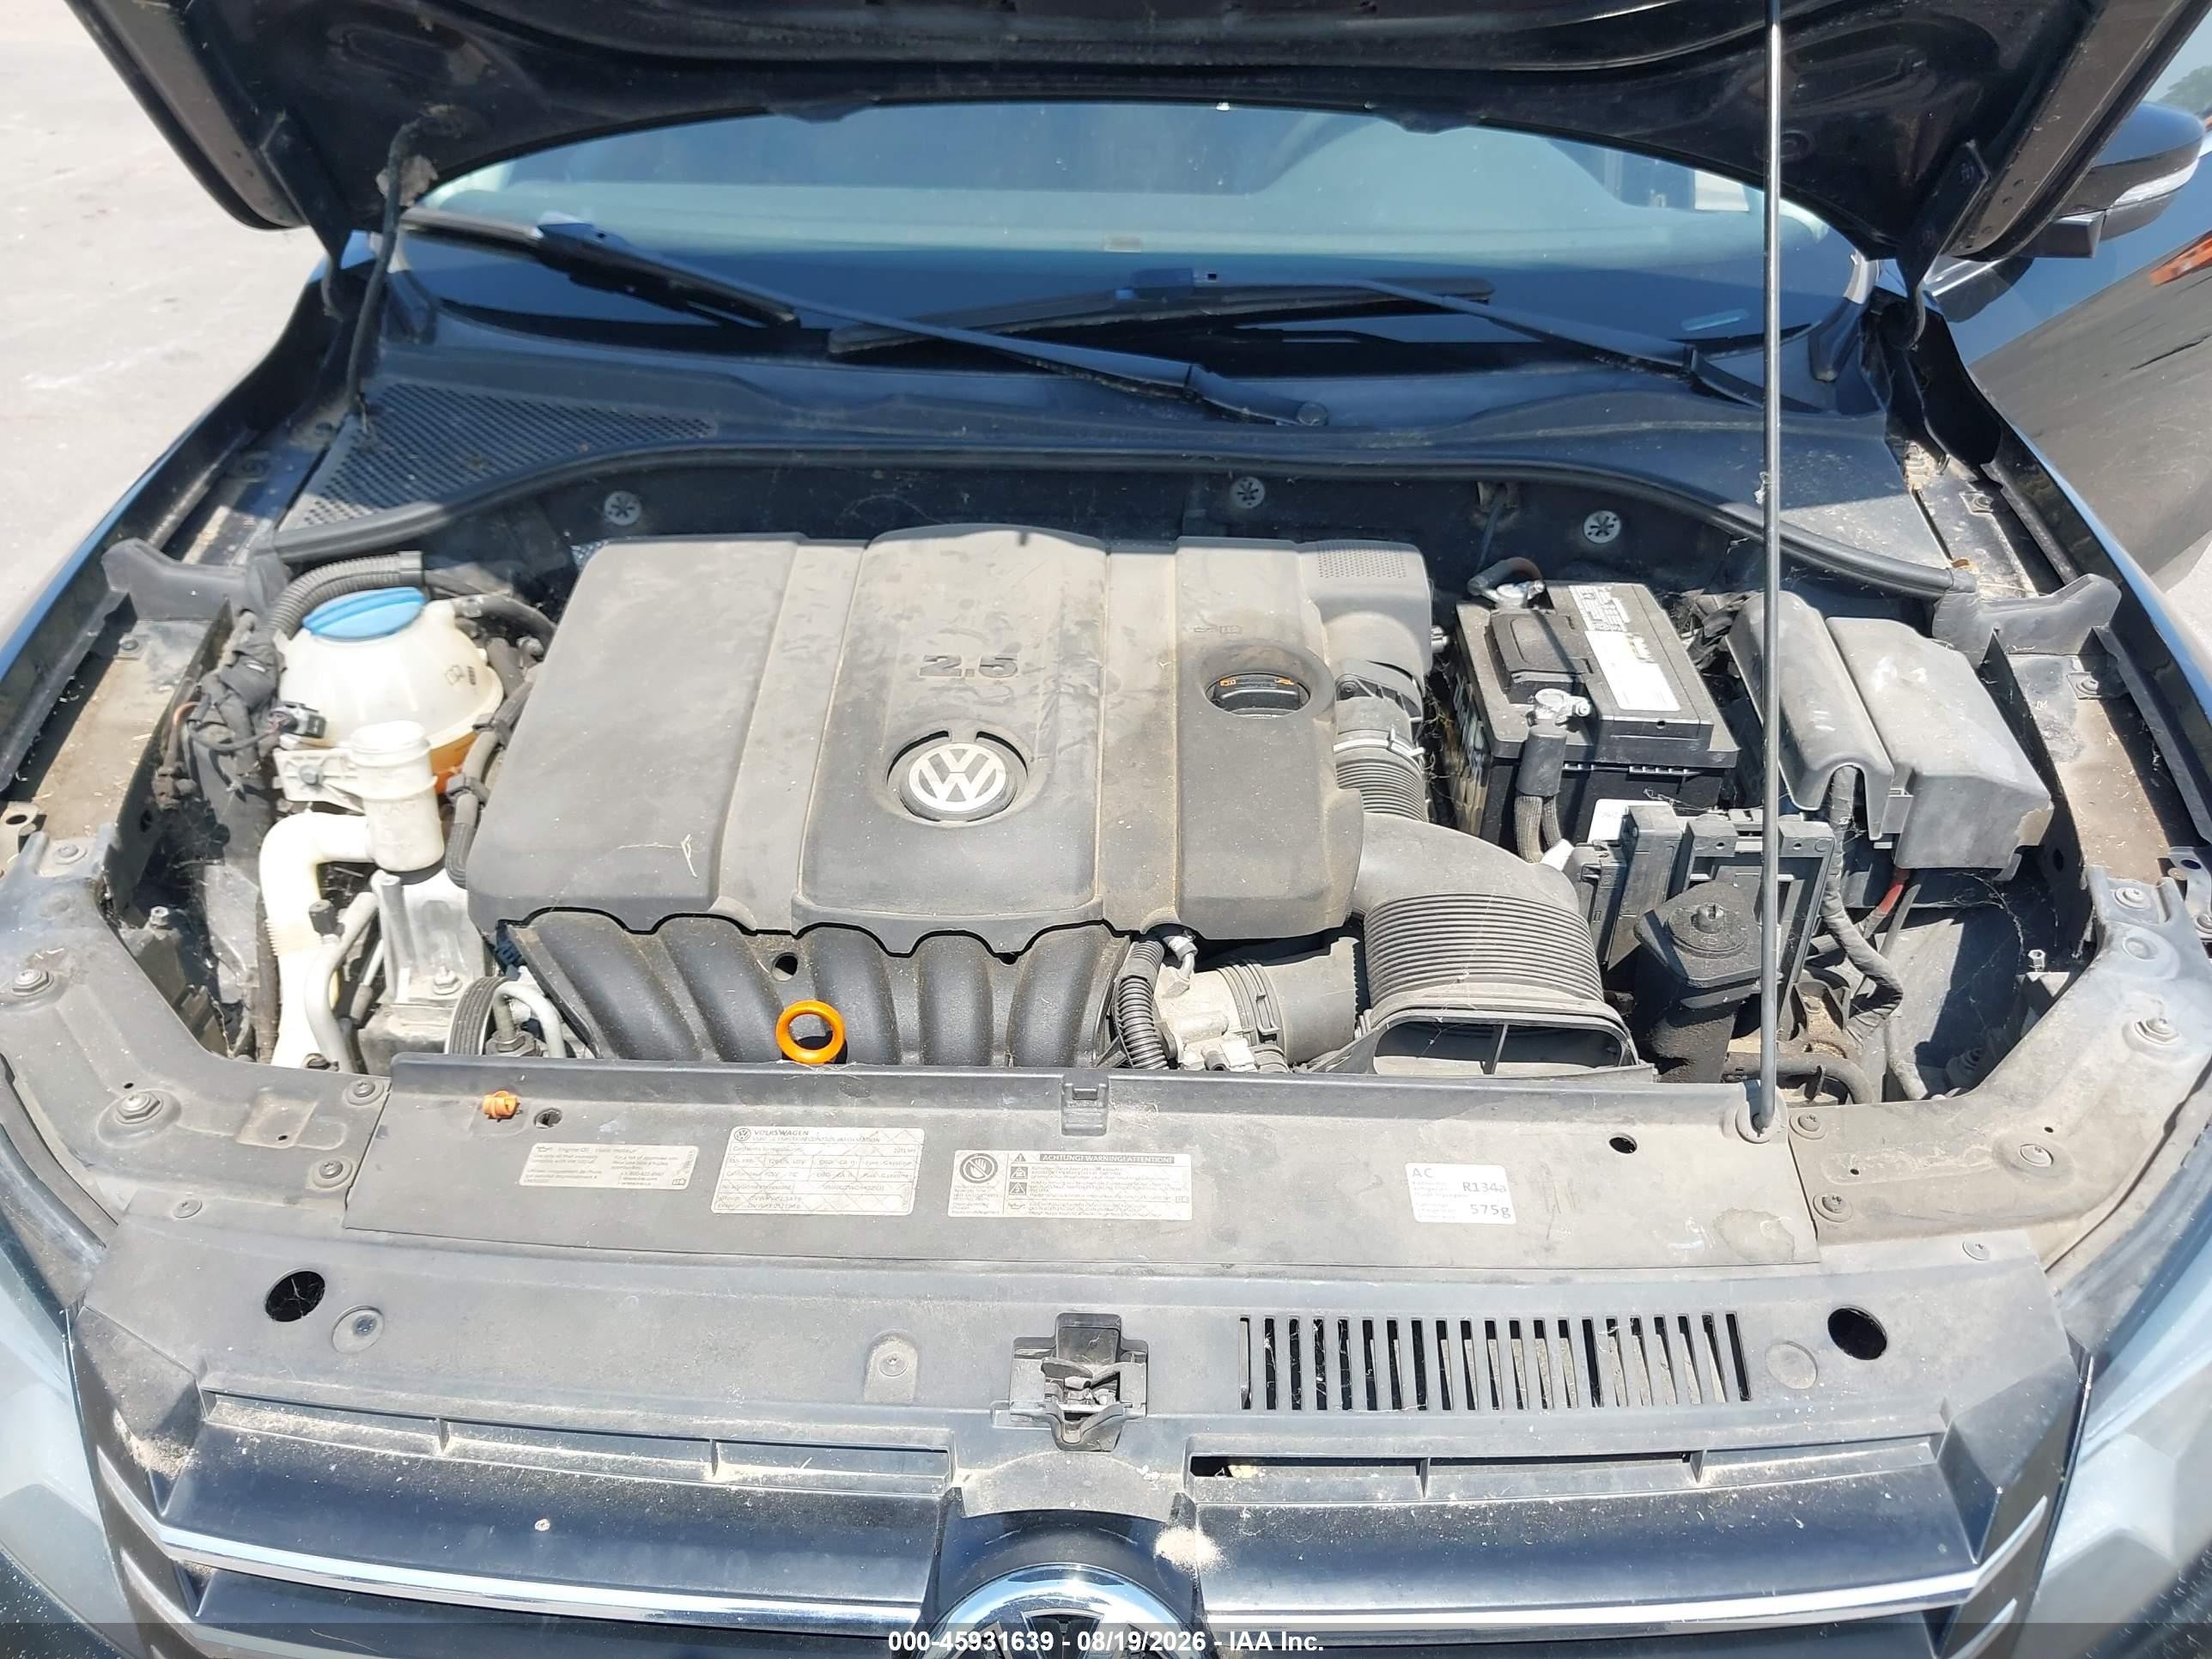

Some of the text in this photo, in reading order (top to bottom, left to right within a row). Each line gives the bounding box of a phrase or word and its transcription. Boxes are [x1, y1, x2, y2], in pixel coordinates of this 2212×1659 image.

[919, 653, 1019, 678] 2.5
[1412, 1167, 1436, 1179] AC
[1462, 1182, 1507, 1194] R134a
[1469, 1204, 1511, 1219] 575g
